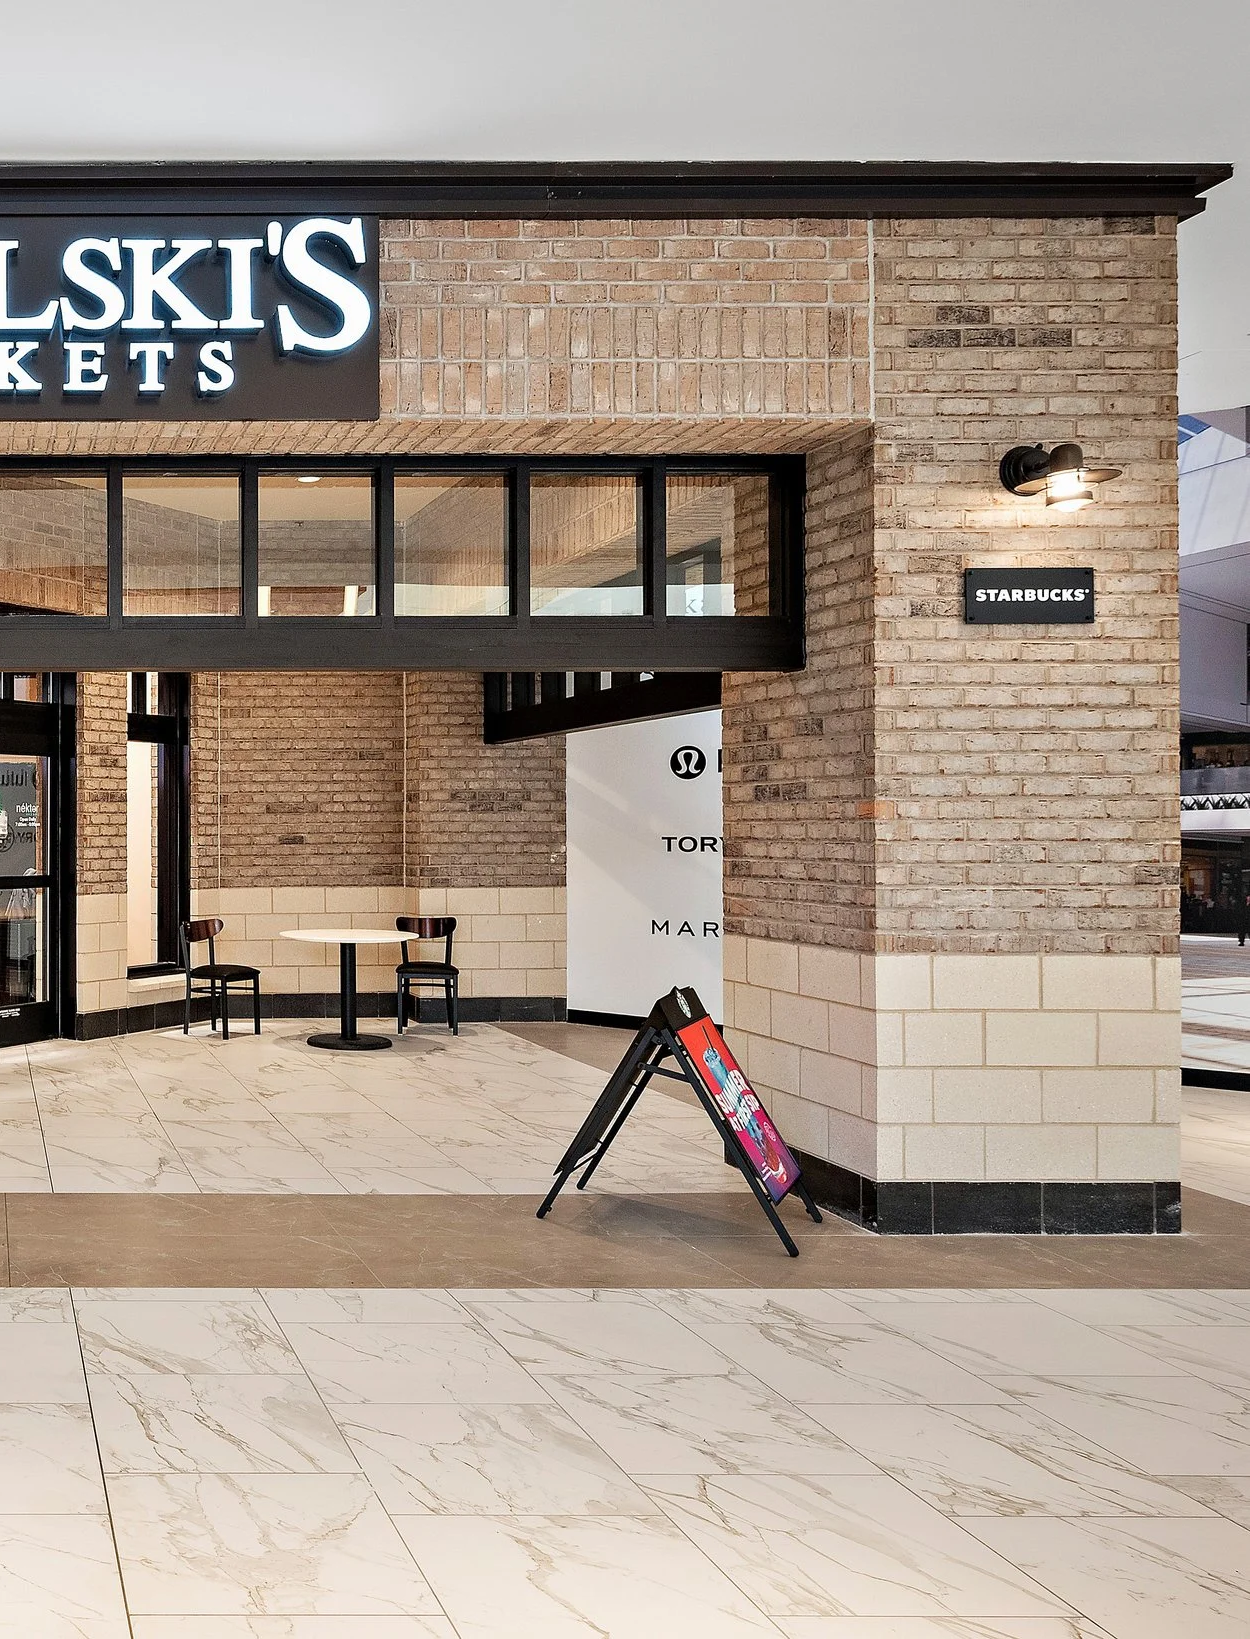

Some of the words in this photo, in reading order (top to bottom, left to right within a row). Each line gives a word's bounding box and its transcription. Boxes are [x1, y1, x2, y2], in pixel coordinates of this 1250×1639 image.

[975, 589, 1086, 602] STARBUCKS
[661, 836, 723, 853] TOR
[715, 1070, 750, 1113] SUMMER
[728, 1116, 743, 1132] AT
